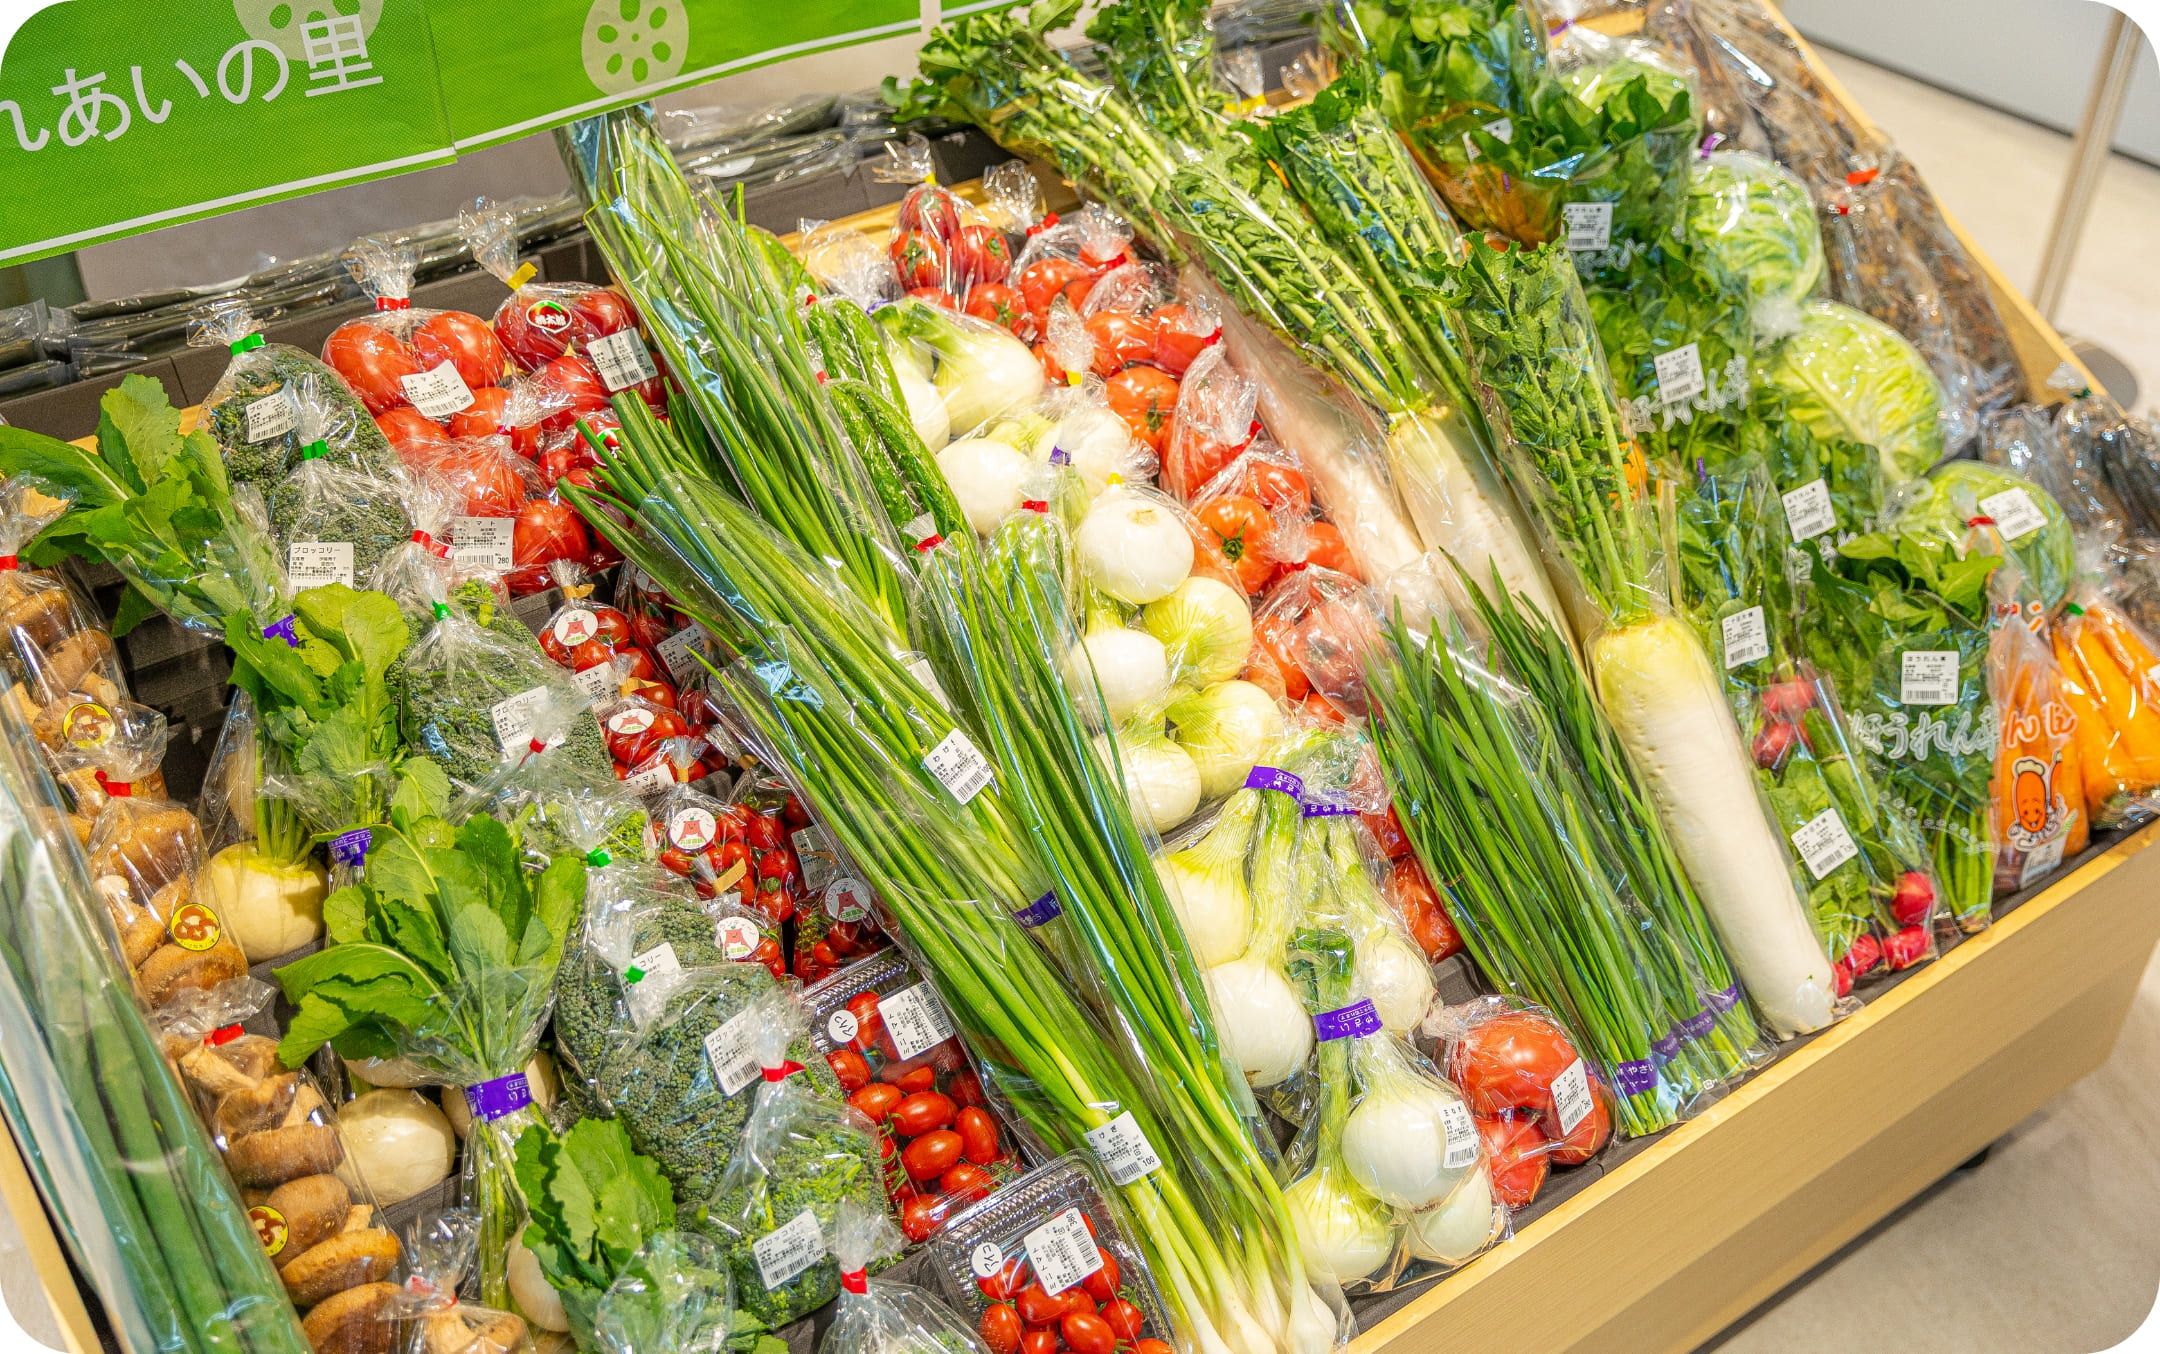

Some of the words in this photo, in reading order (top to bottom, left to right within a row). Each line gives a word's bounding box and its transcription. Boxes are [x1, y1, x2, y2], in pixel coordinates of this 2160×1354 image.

[293, 545, 341, 554] ブロッコリー
[662, 627, 699, 652] ミニトマト
[624, 773, 658, 788] ニトマト
[639, 953, 662, 968] コリー
[888, 1013, 912, 1055] ミニトマト
[1141, 1154, 1156, 1167] 100
[757, 1221, 803, 1251] ブロッコリー
[1031, 1247, 1058, 1290] ミニトマト
